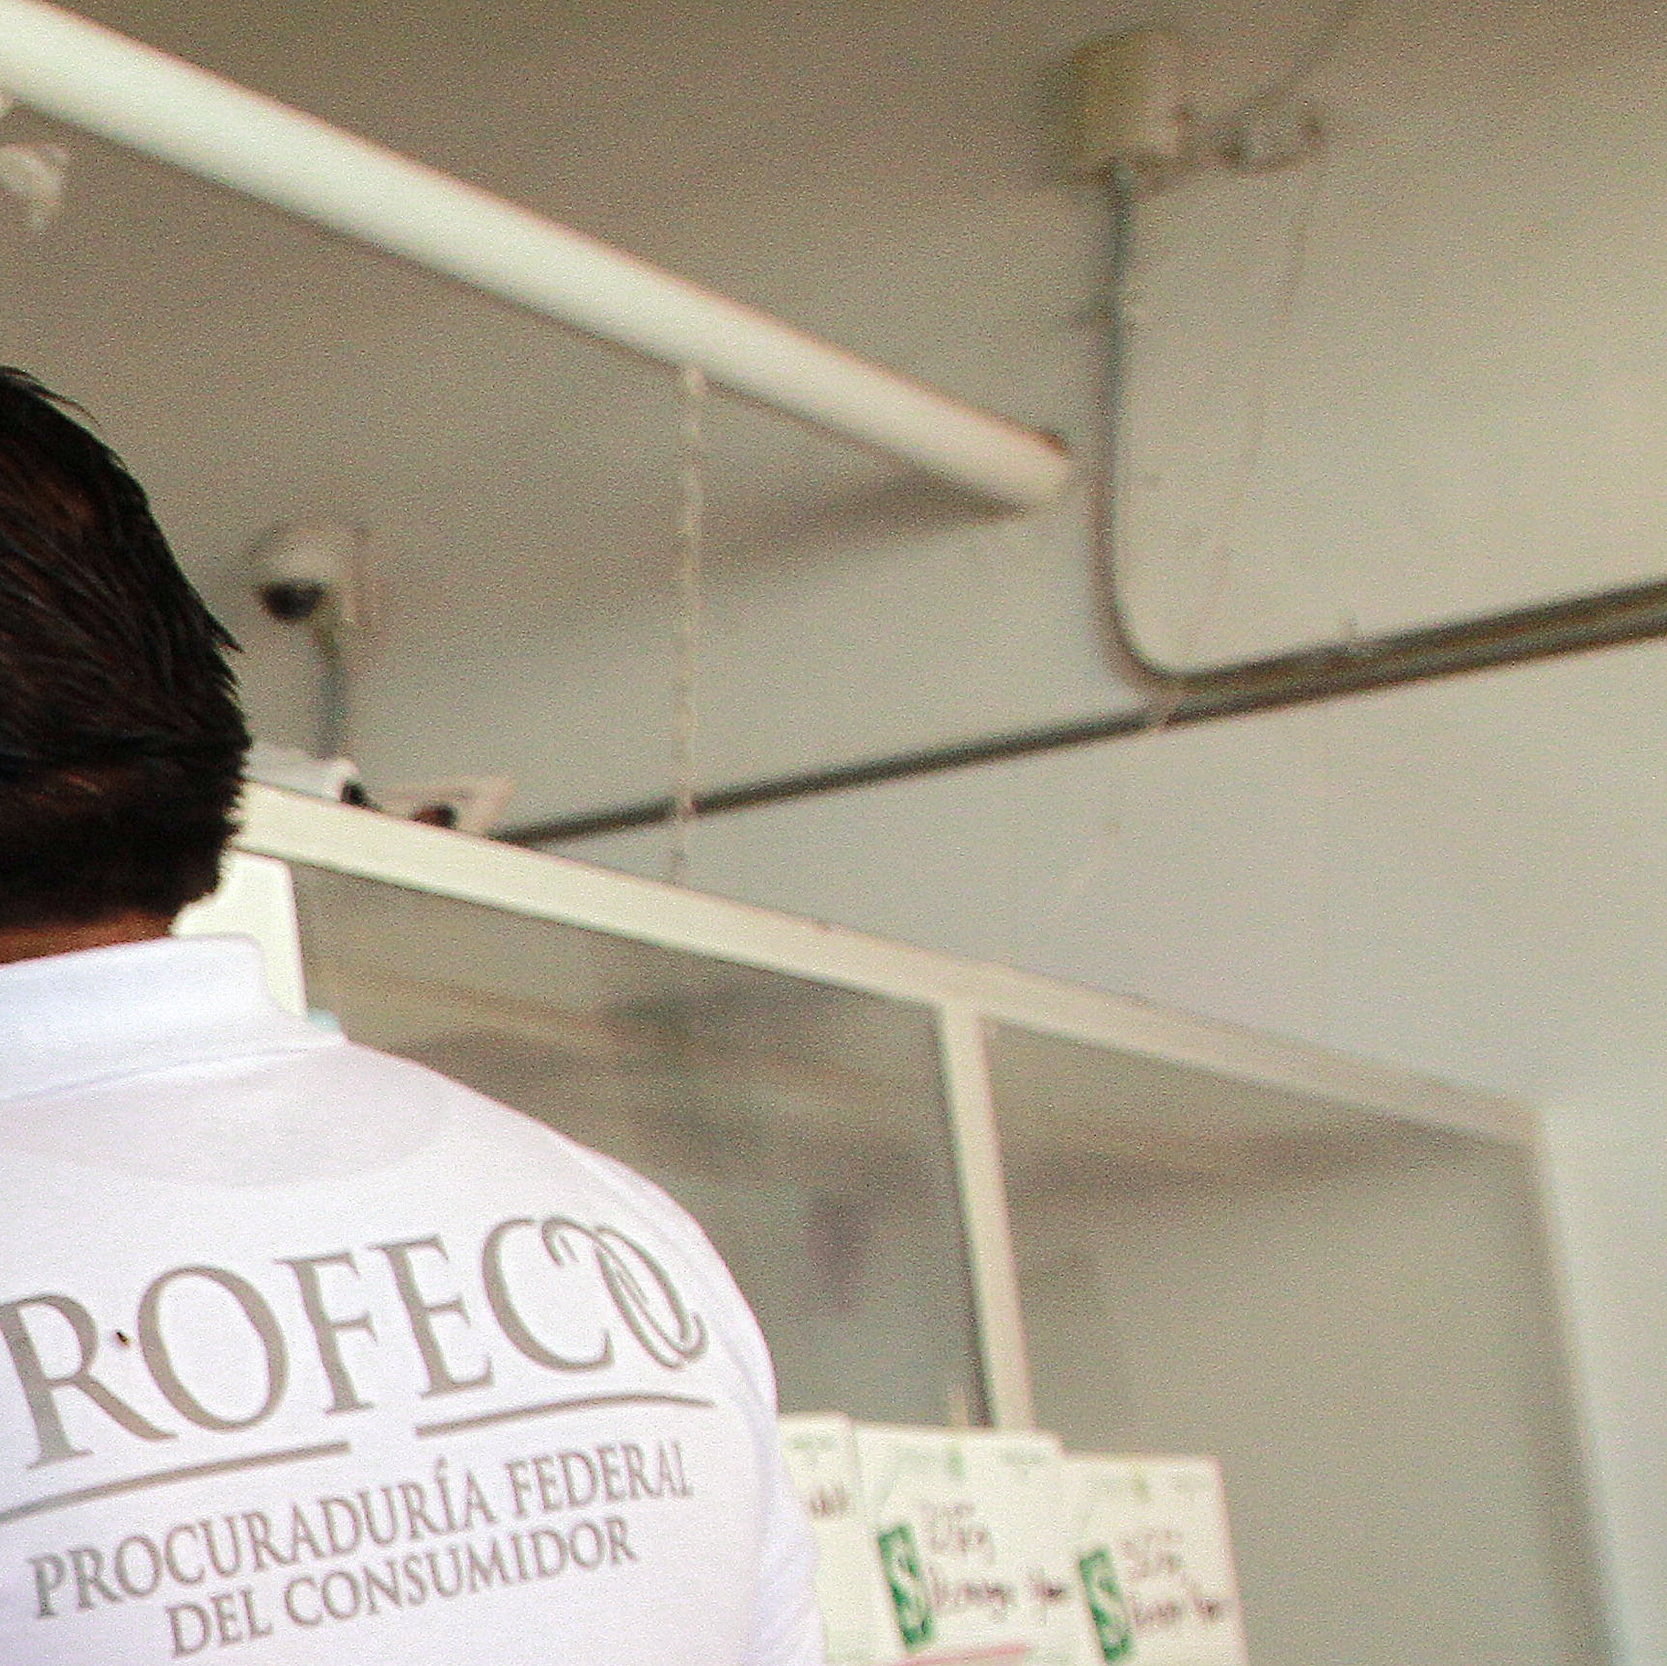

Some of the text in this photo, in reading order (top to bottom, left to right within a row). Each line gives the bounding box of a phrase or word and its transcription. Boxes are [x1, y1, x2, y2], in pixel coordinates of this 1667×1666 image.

[31, 1439, 695, 1621] PROCURADURÍA FEDERAL
[167, 1516, 638, 1660] DEL CONSUMIDOR
